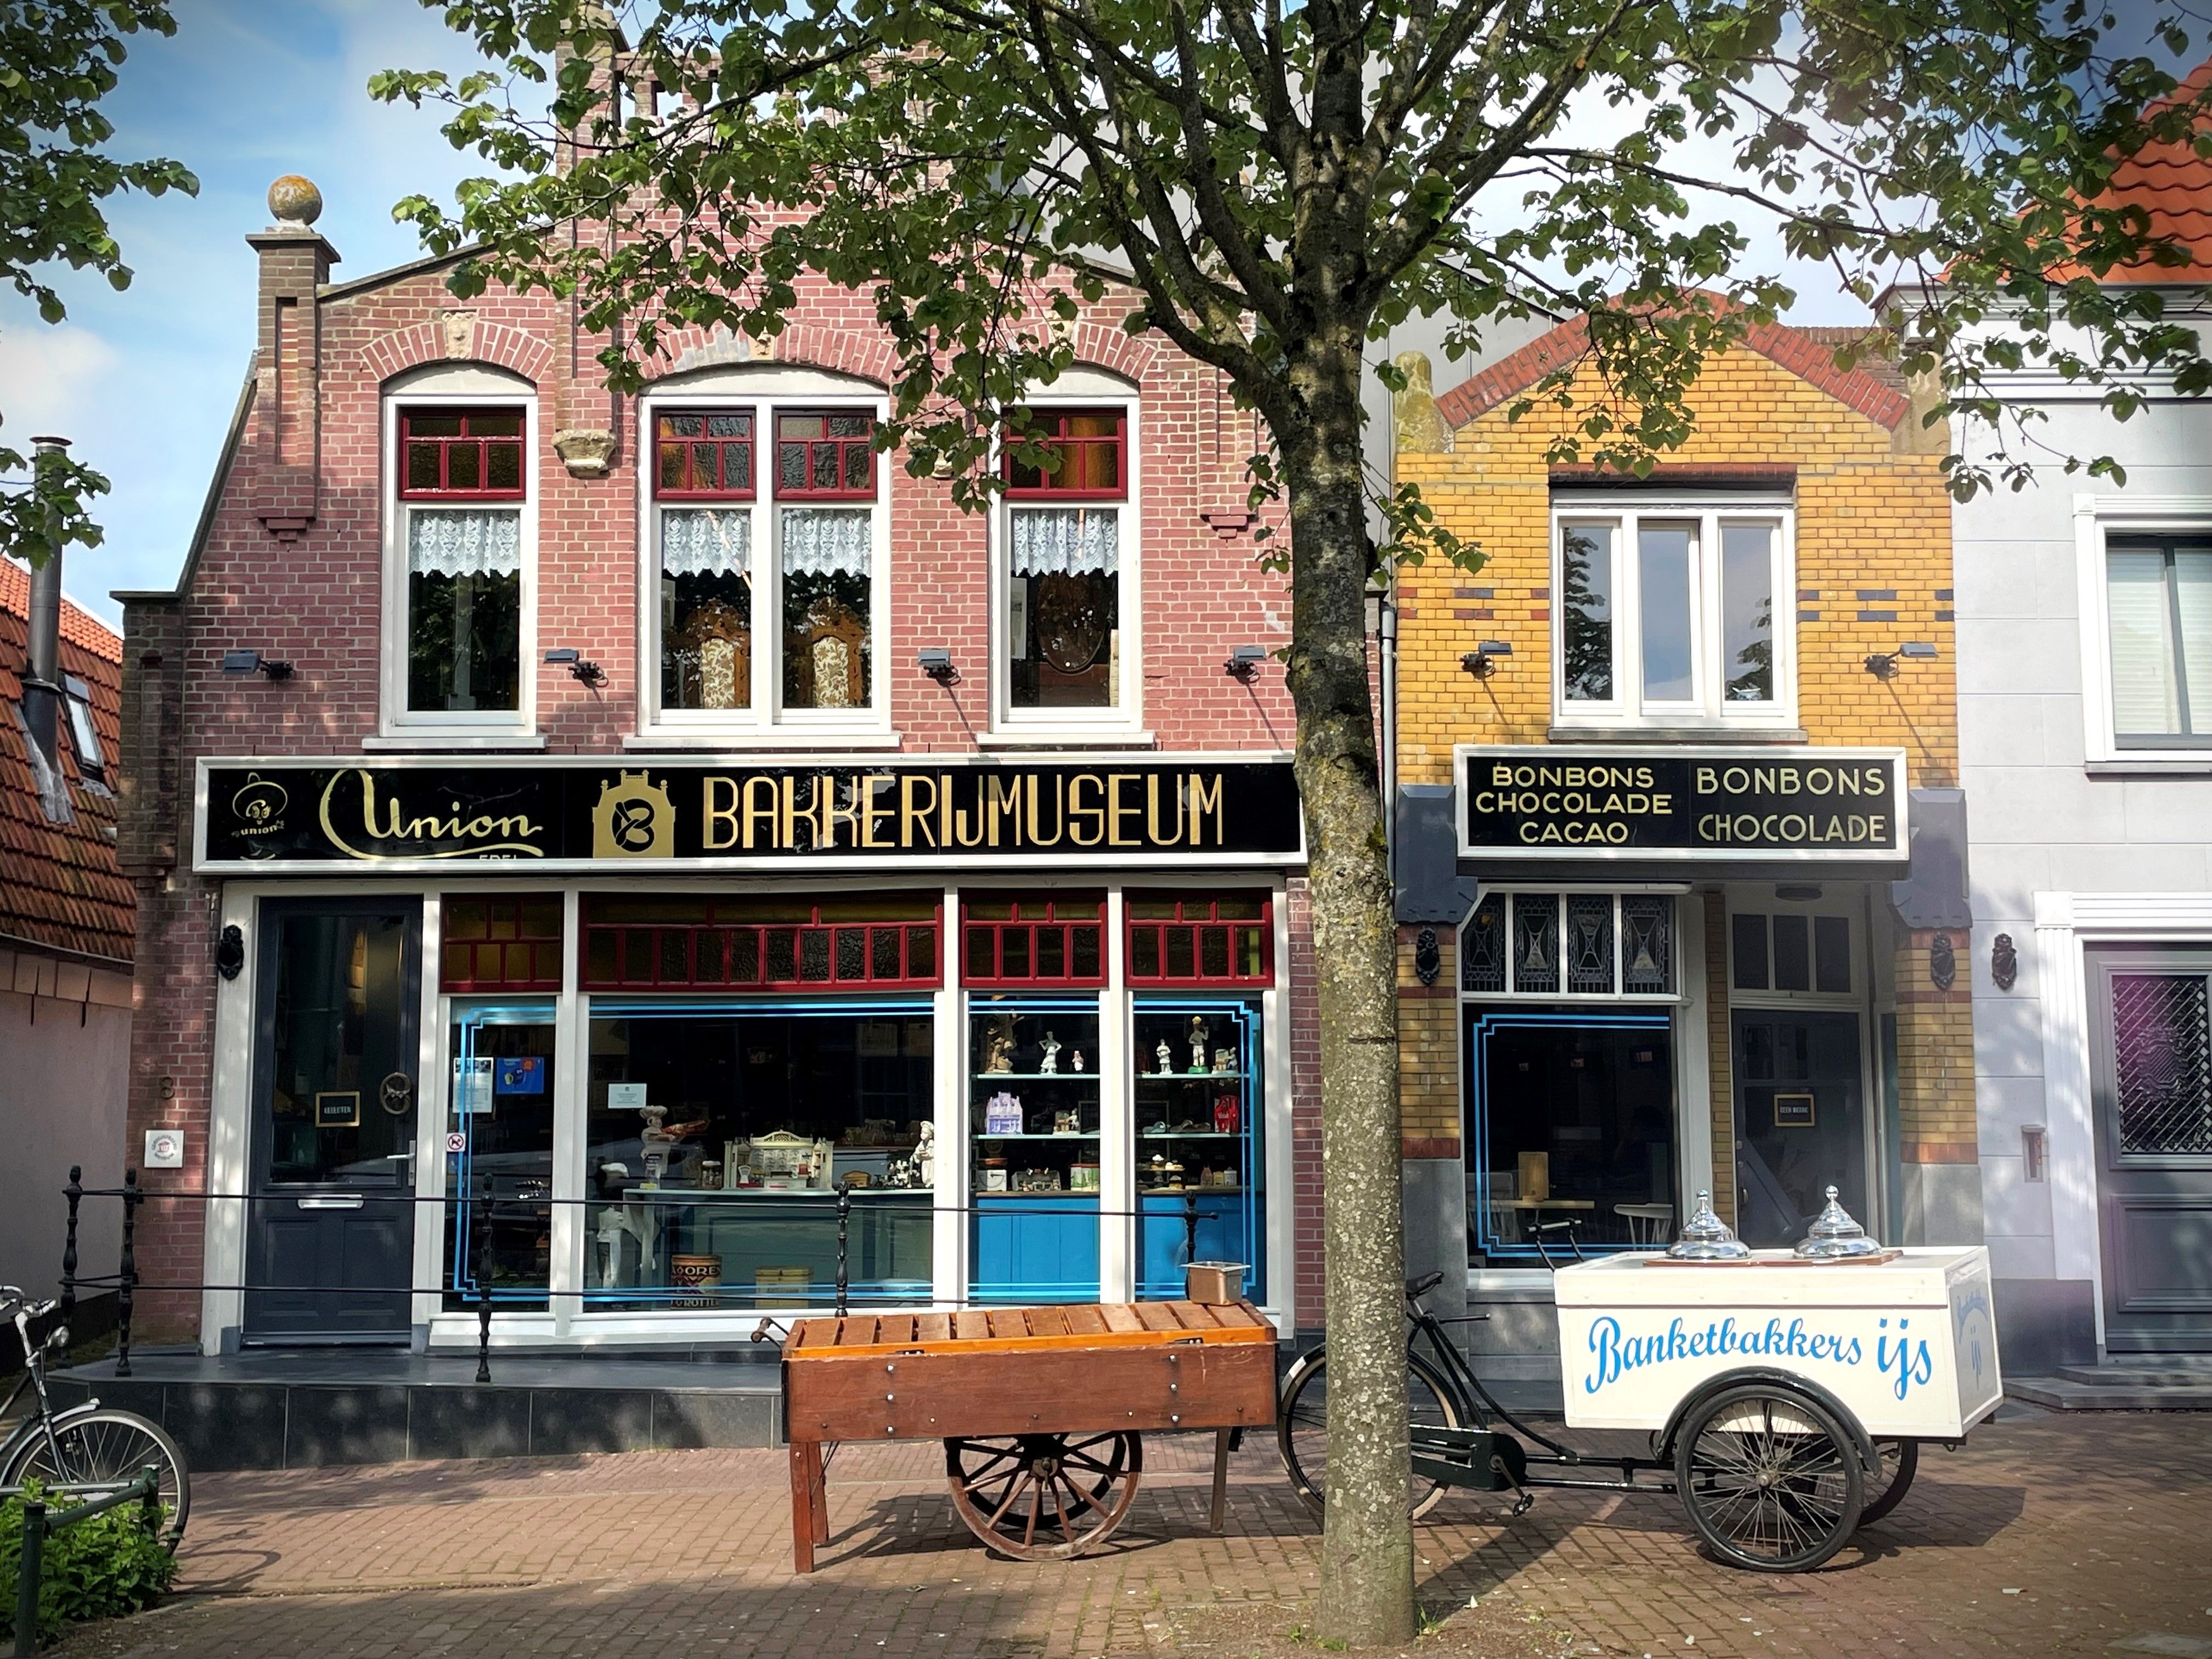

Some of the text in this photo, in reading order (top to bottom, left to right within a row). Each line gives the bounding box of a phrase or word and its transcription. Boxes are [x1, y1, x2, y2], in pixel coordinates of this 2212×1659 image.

[1492, 766, 1655, 788] BONBONS
[1697, 766, 1886, 797] BONBONS
[319, 769, 544, 859] Union
[703, 774, 1223, 848] BAKKERIJMUSEUM
[1476, 792, 1672, 815] CHOCOLADE
[1520, 821, 1628, 844] CACAO
[1699, 814, 1887, 843] CHOCOLADE
[1585, 1316, 1862, 1395] Banketbakkers
[1877, 1317, 1932, 1401] ijs
